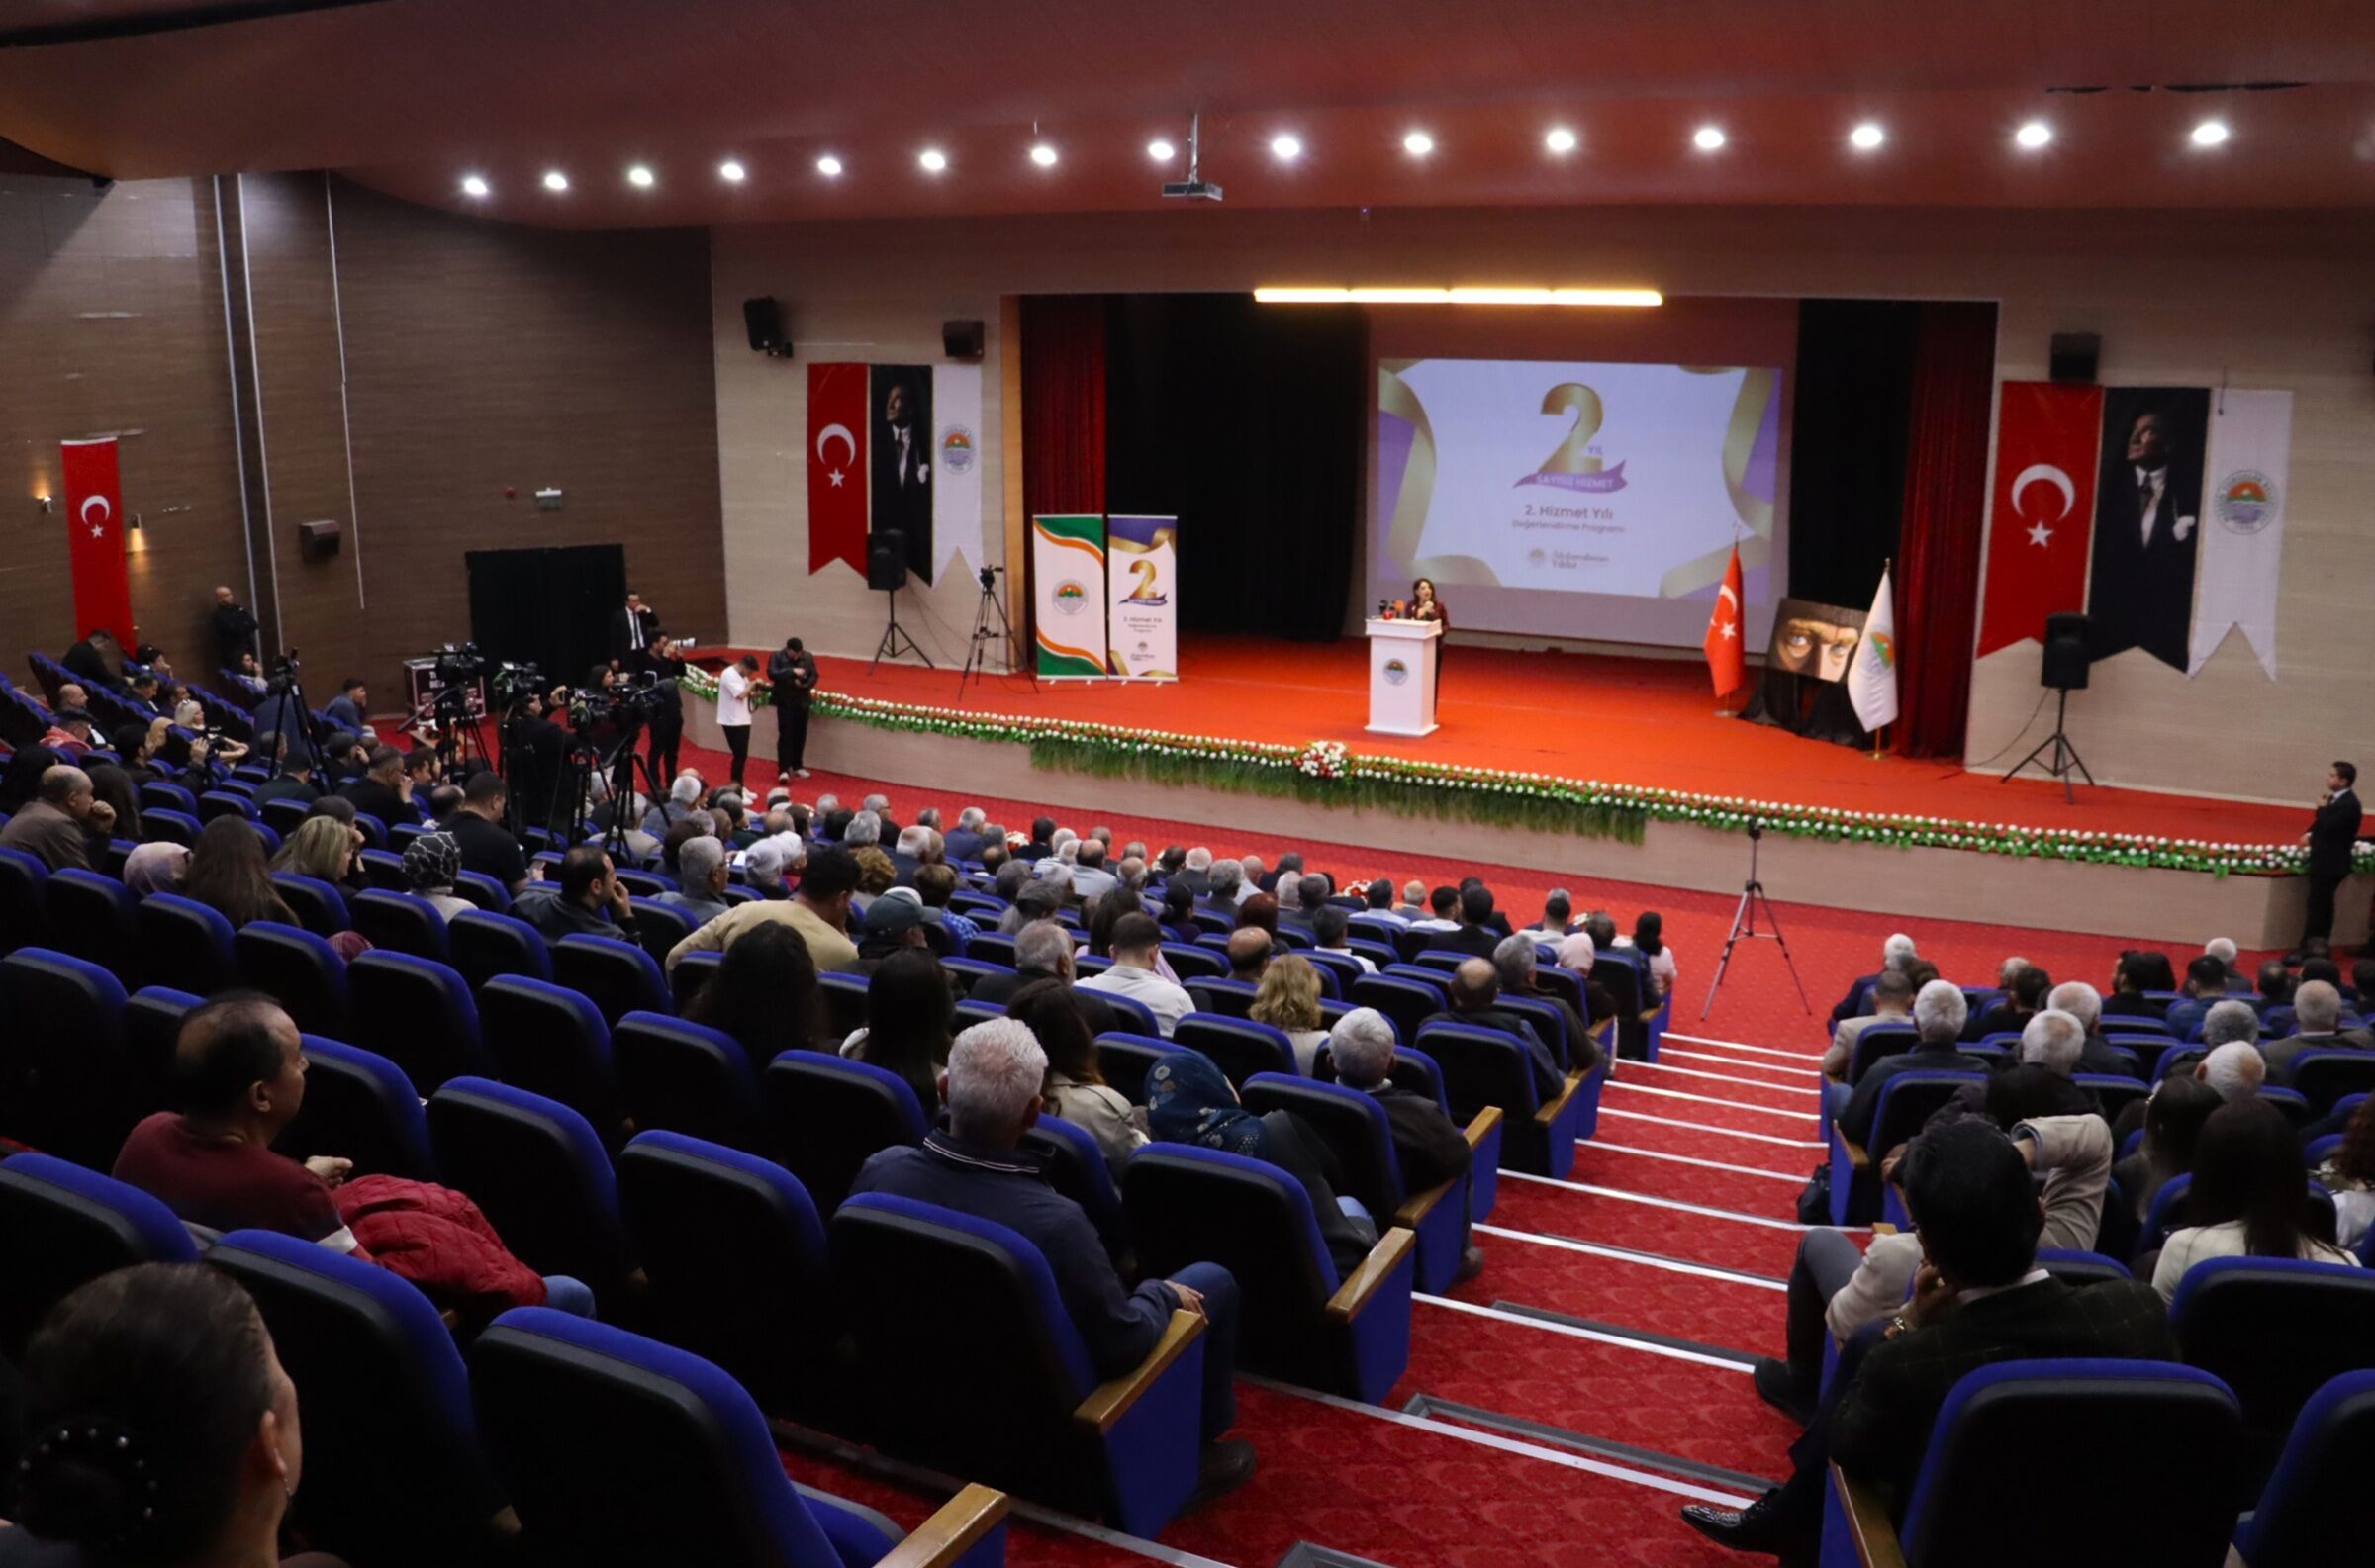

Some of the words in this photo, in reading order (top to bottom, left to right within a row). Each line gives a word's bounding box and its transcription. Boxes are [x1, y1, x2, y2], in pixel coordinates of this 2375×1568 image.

[1540, 382, 1603, 474] 2
[1524, 504, 1535, 516] 2.
[1540, 506, 1588, 519] Hizmet
[1591, 507, 1613, 520] Yılı
[1129, 559, 1156, 599] 2
